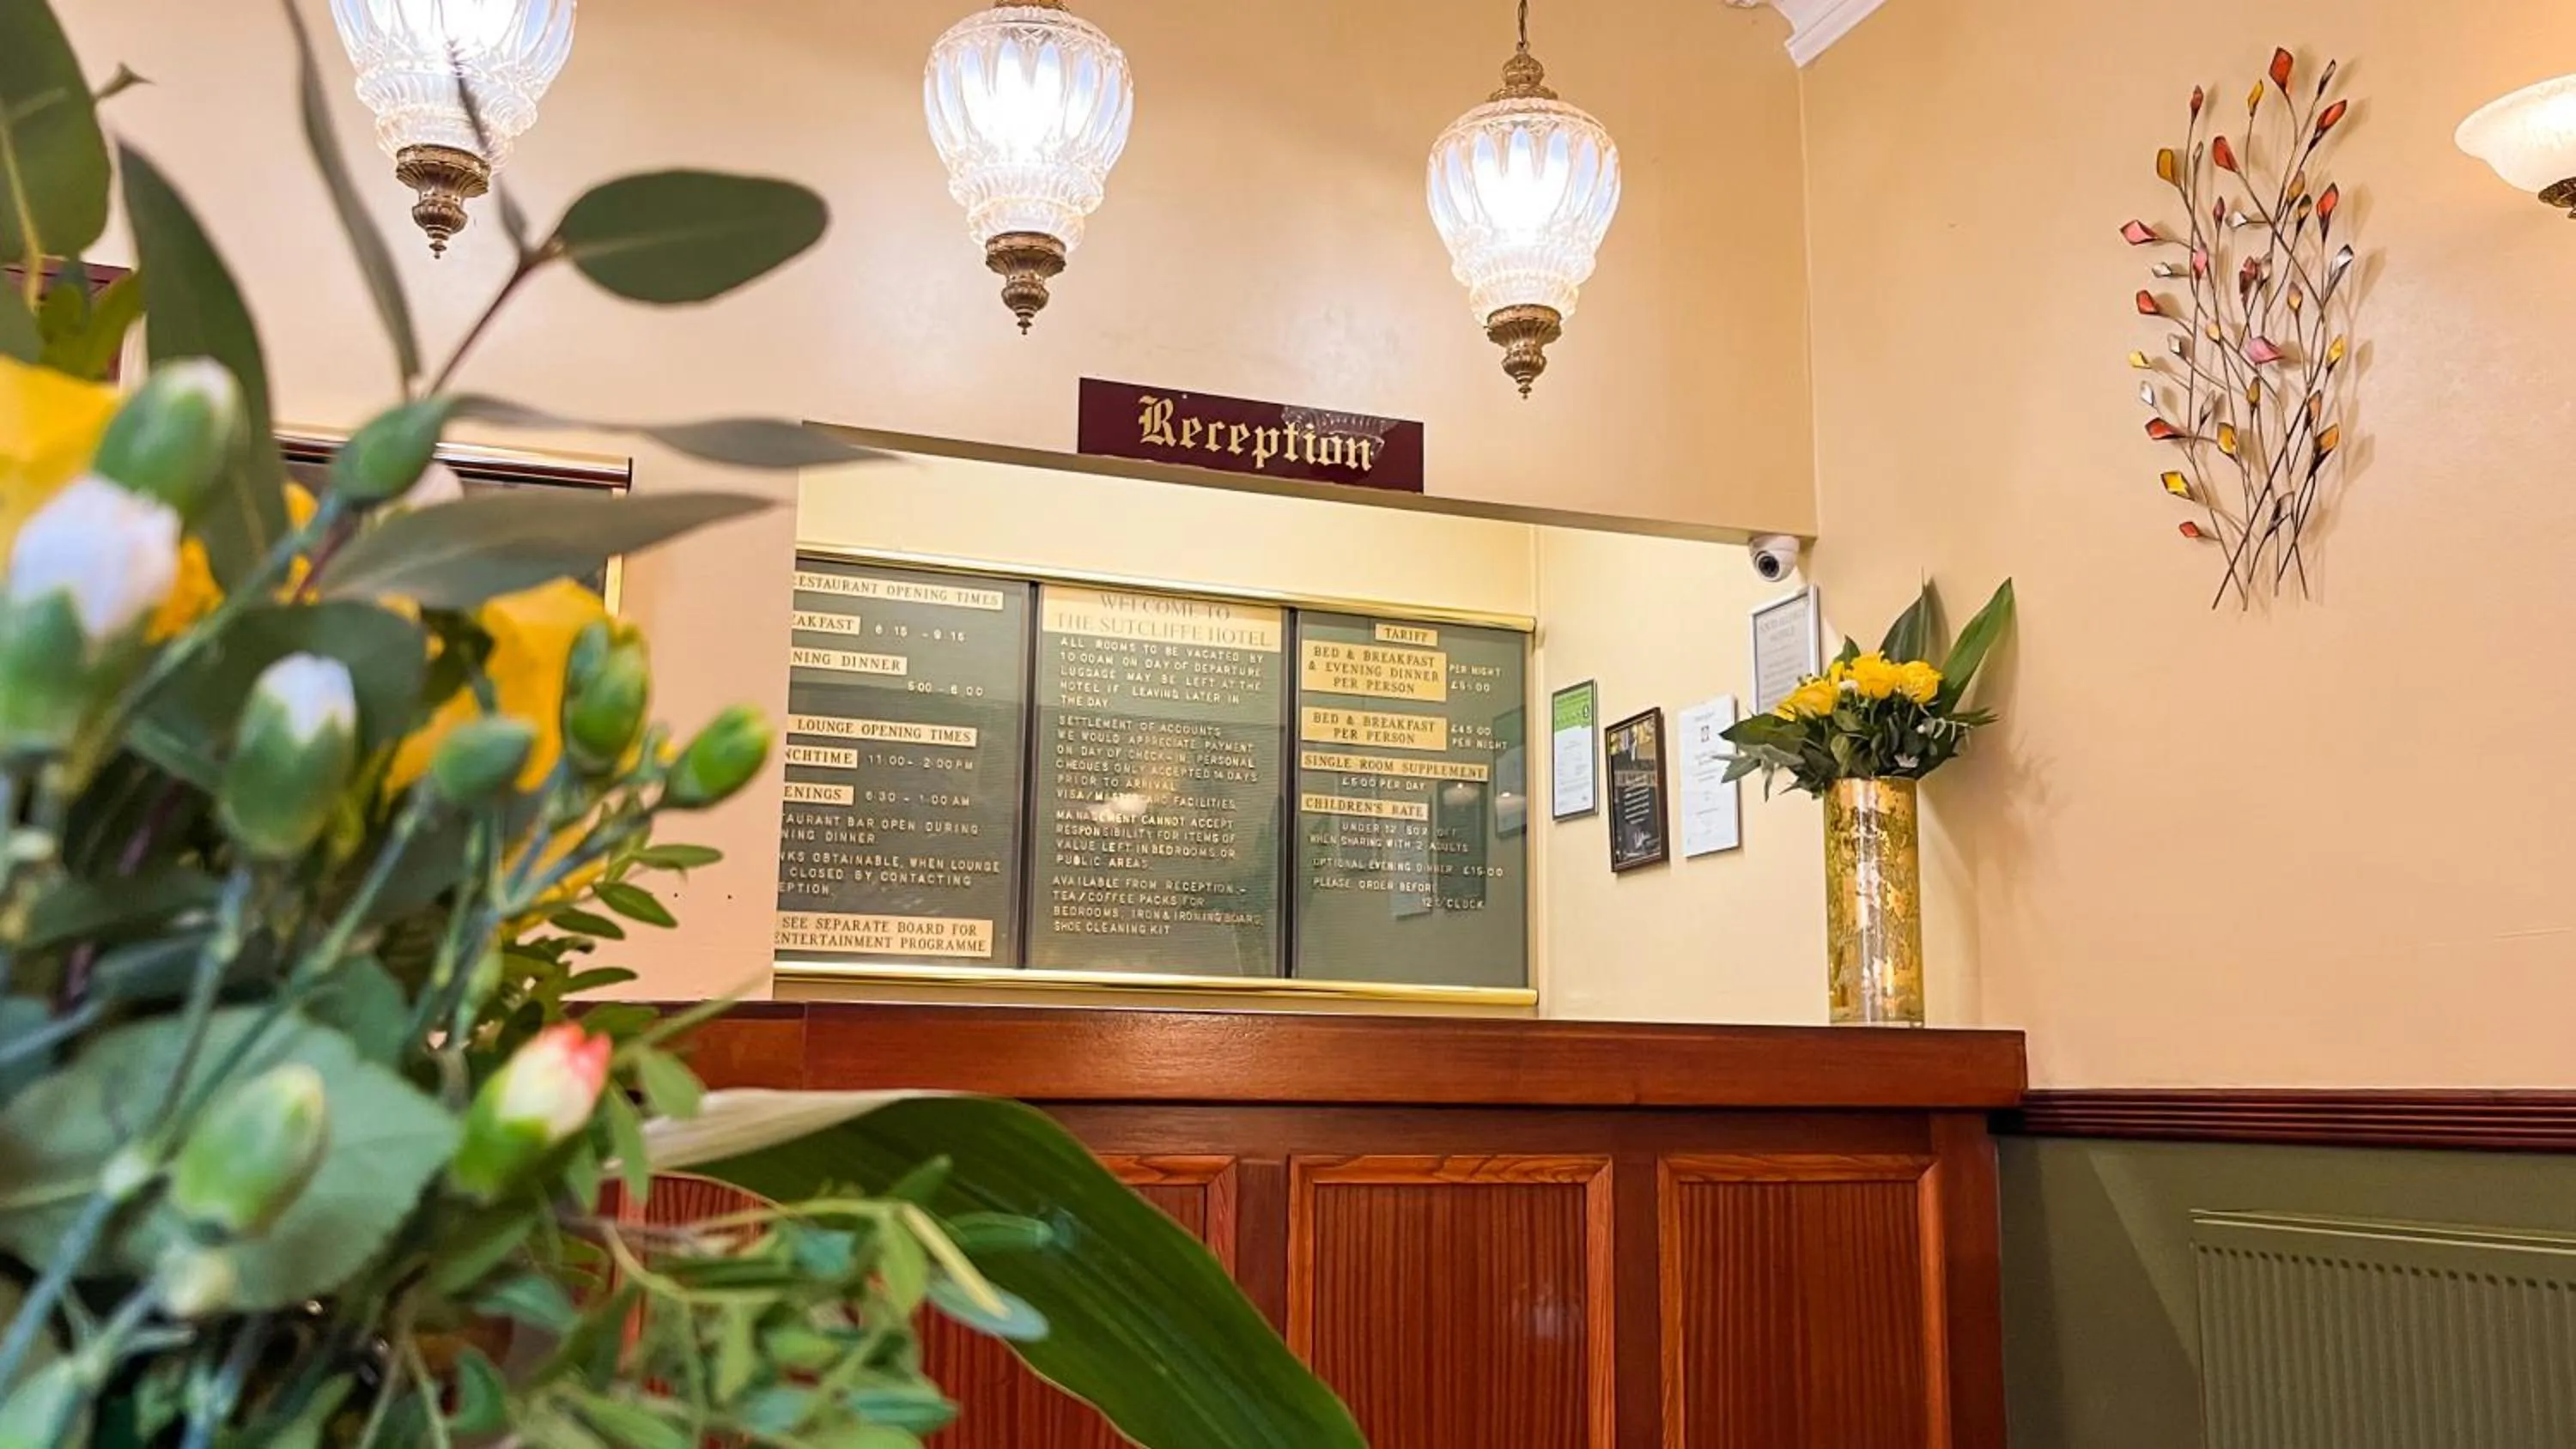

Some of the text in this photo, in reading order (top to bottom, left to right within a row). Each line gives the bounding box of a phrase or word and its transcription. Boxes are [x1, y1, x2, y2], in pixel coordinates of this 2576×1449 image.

[1138, 394, 1372, 472] Reception
[887, 585, 947, 601] OPENING
[956, 592, 999, 606] TIMES
[1100, 593, 1230, 621] WELCOME TO
[1057, 613, 1273, 646] THE SUTCLIFFE HOTEL
[1385, 627, 1429, 642] TARIFF
[1060, 637, 1263, 664] ALL ROOMS TO BE VACATED BY
[1314, 646, 1436, 667] BED & BREAKFAST
[841, 656, 901, 671] DINNER
[1123, 657, 1261, 677] ON DAY OF DEPARTURE
[1309, 661, 1439, 682] & EVENING DINNER
[1449, 664, 1502, 677] PER NIGHT
[1060, 667, 1261, 692] LUGGAGE MAY BE LEFT AT THE
[1334, 677, 1415, 694] PER PERSON
[1060, 682, 1240, 705] HOTEL IF LEAVING LATER IN
[1060, 695, 1109, 708] THE DAY
[798, 718, 971, 743] LOUNGE OPENING TIMES
[1059, 716, 1221, 737] SETTLEMENT OF ACCOUNTS
[1313, 712, 1436, 733] BED & BREAKFAST
[1058, 730, 1255, 754] WE WOULD APPRECIATE PAYMENT
[1334, 728, 1415, 744] PER PERSON
[1453, 737, 1508, 749] PER NIGHT
[1057, 745, 1255, 768] ON DAY OF PERSONAL
[1055, 760, 1109, 773] CHEQUES
[1114, 762, 1145, 774] ONLY
[1152, 766, 1211, 779] ACCEPTED
[1227, 771, 1258, 783] DAYS
[1304, 755, 1485, 779] SINGLE ROOM SUPPLEMENT
[1057, 774, 1176, 791] PRIOR TO ARRIVAL
[1380, 779, 1425, 791] PER DAY
[784, 786, 841, 800] ENINGS
[951, 796, 969, 807] AM
[1306, 797, 1424, 816] CHILDREN'S RATE
[848, 817, 874, 828] BAR
[882, 820, 915, 831] OPEN
[927, 822, 979, 834] DURING
[1141, 815, 1185, 828] CANNOT
[1191, 819, 1233, 830] ACCEPT
[1342, 822, 1397, 834] UNDER 12
[1056, 825, 1236, 844] RESPONSIBILITY FOR ITEMS OF
[1310, 834, 1337, 844] WHEN
[1341, 835, 1382, 847] SHARING
[1386, 839, 1412, 849] WITH
[1056, 840, 1095, 852] VALUE
[1102, 842, 1131, 853] LEFT
[1137, 845, 1148, 854] IN
[1221, 849, 1236, 859] OR
[910, 858, 945, 870] WHEN
[951, 859, 1000, 873] LOUNGE
[1056, 854, 1101, 867] PUBLIC
[1313, 858, 1366, 871] OPTIONAL
[1369, 858, 1411, 872] EVENING
[789, 867, 971, 886] CLOSED BY CONTACTING
[1053, 876, 1119, 889] AVAILABLE
[1125, 880, 1157, 890] FROM
[1313, 877, 1351, 888] PLEASE
[1359, 879, 1394, 890] ORDER
[1054, 891, 1206, 908] TEA/COFFEE PACKS FOR
[1421, 897, 1432, 907] 12
[1132, 909, 1161, 921] IRON
[782, 917, 977, 937] SEE SEPARATE BOARD FOR
[1054, 921, 1170, 936] SHOE CLEANING KIT
[774, 931, 986, 952] ENTERTAINMENT PROGRAMME
